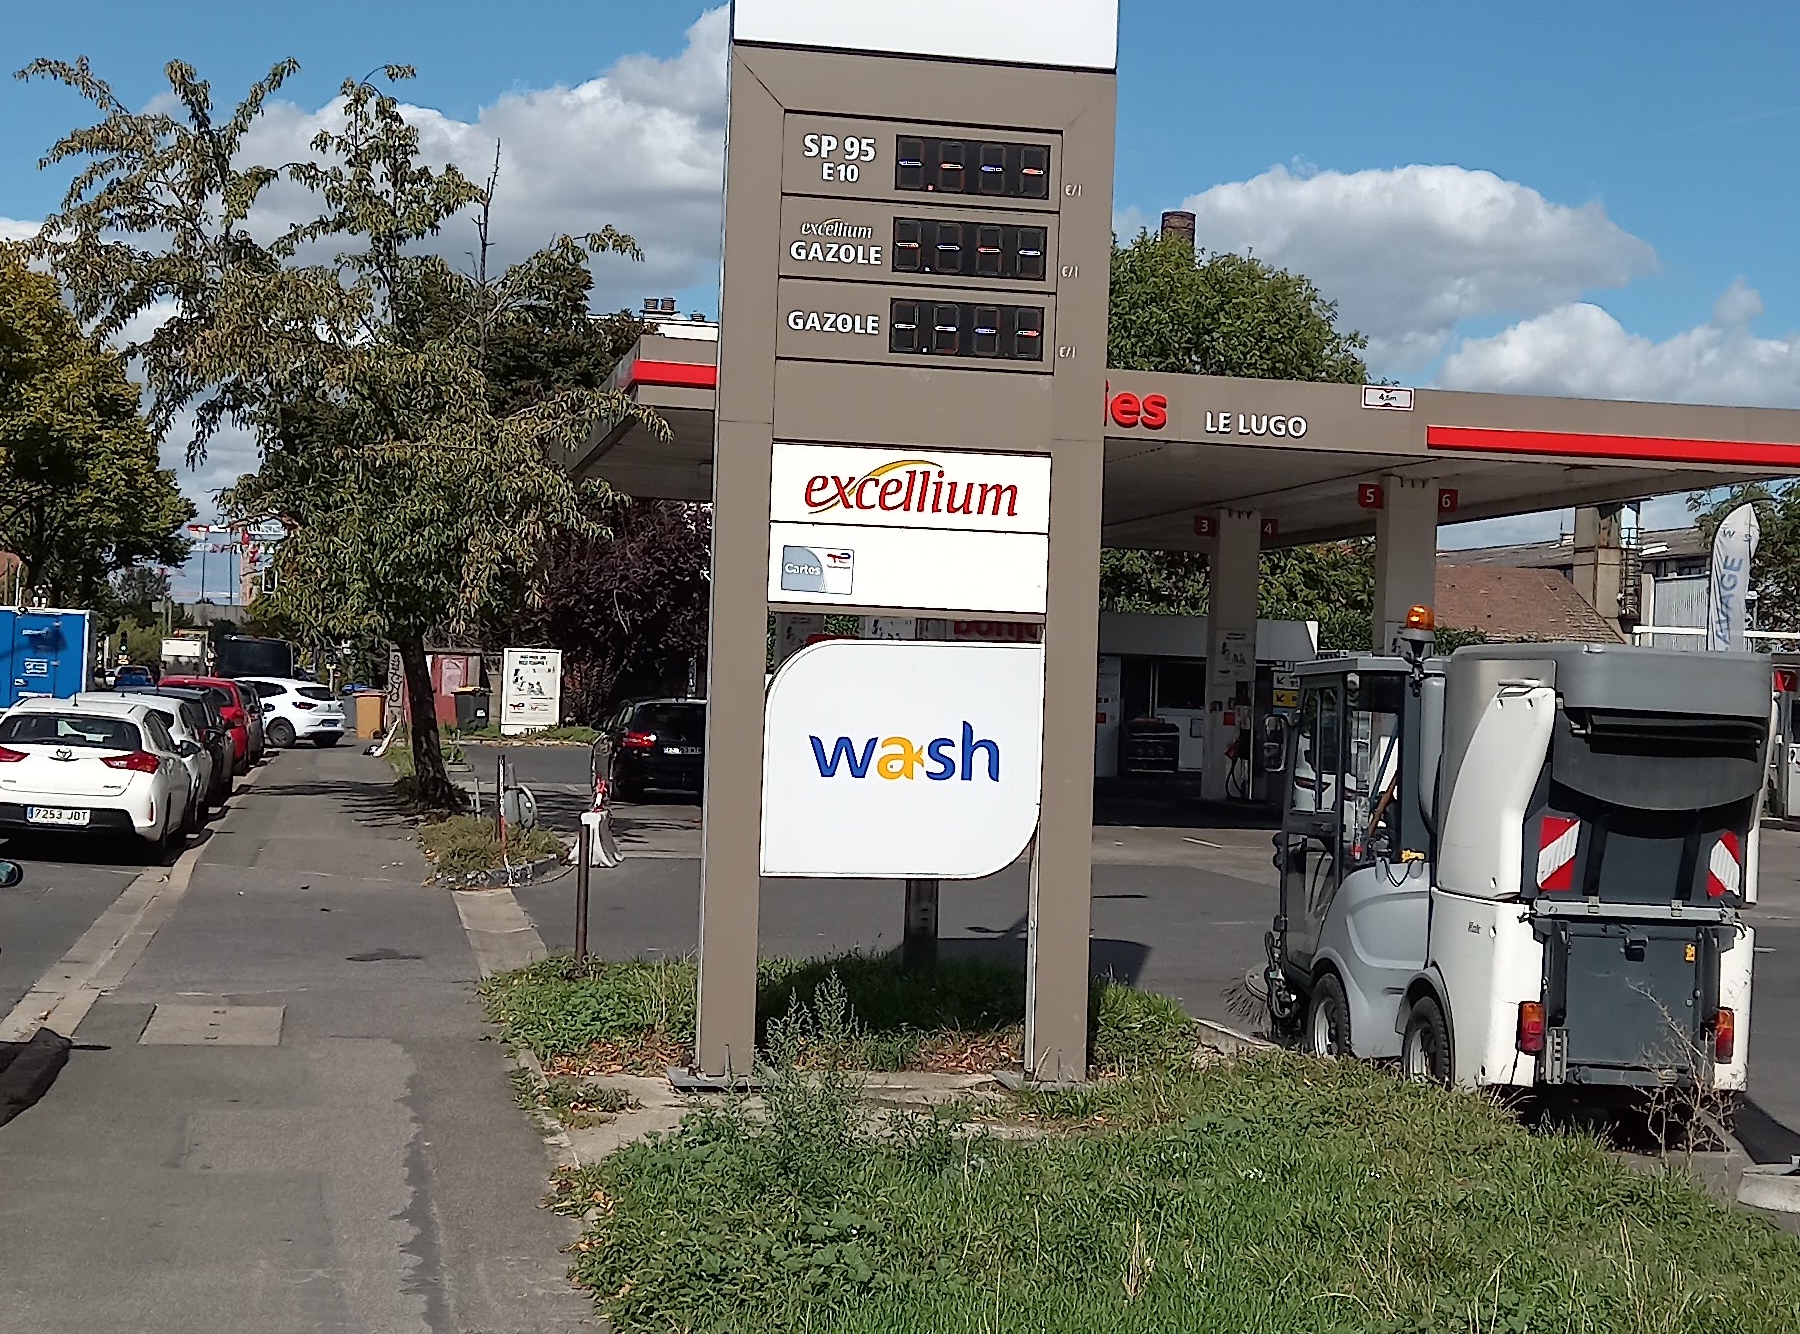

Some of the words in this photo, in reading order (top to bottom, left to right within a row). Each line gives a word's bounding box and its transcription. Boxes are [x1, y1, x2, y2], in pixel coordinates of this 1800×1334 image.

[804, 134, 838, 158] SP
[843, 136, 876, 162] 95
[801, 221, 872, 239] excellium
[790, 241, 882, 265] GAZOLE
[787, 310, 879, 335] GAZOLE
[1103, 379, 1167, 431] es
[1205, 410, 1232, 433] LE
[1238, 413, 1307, 438] LUGO
[804, 468, 1018, 517] excellium
[1364, 488, 1375, 505] 5
[1441, 493, 1451, 509] 6
[1200, 519, 1209, 533] 3
[1263, 522, 1273, 536] 4
[809, 720, 1000, 783] wash
[35, 808, 63, 820] 7253
